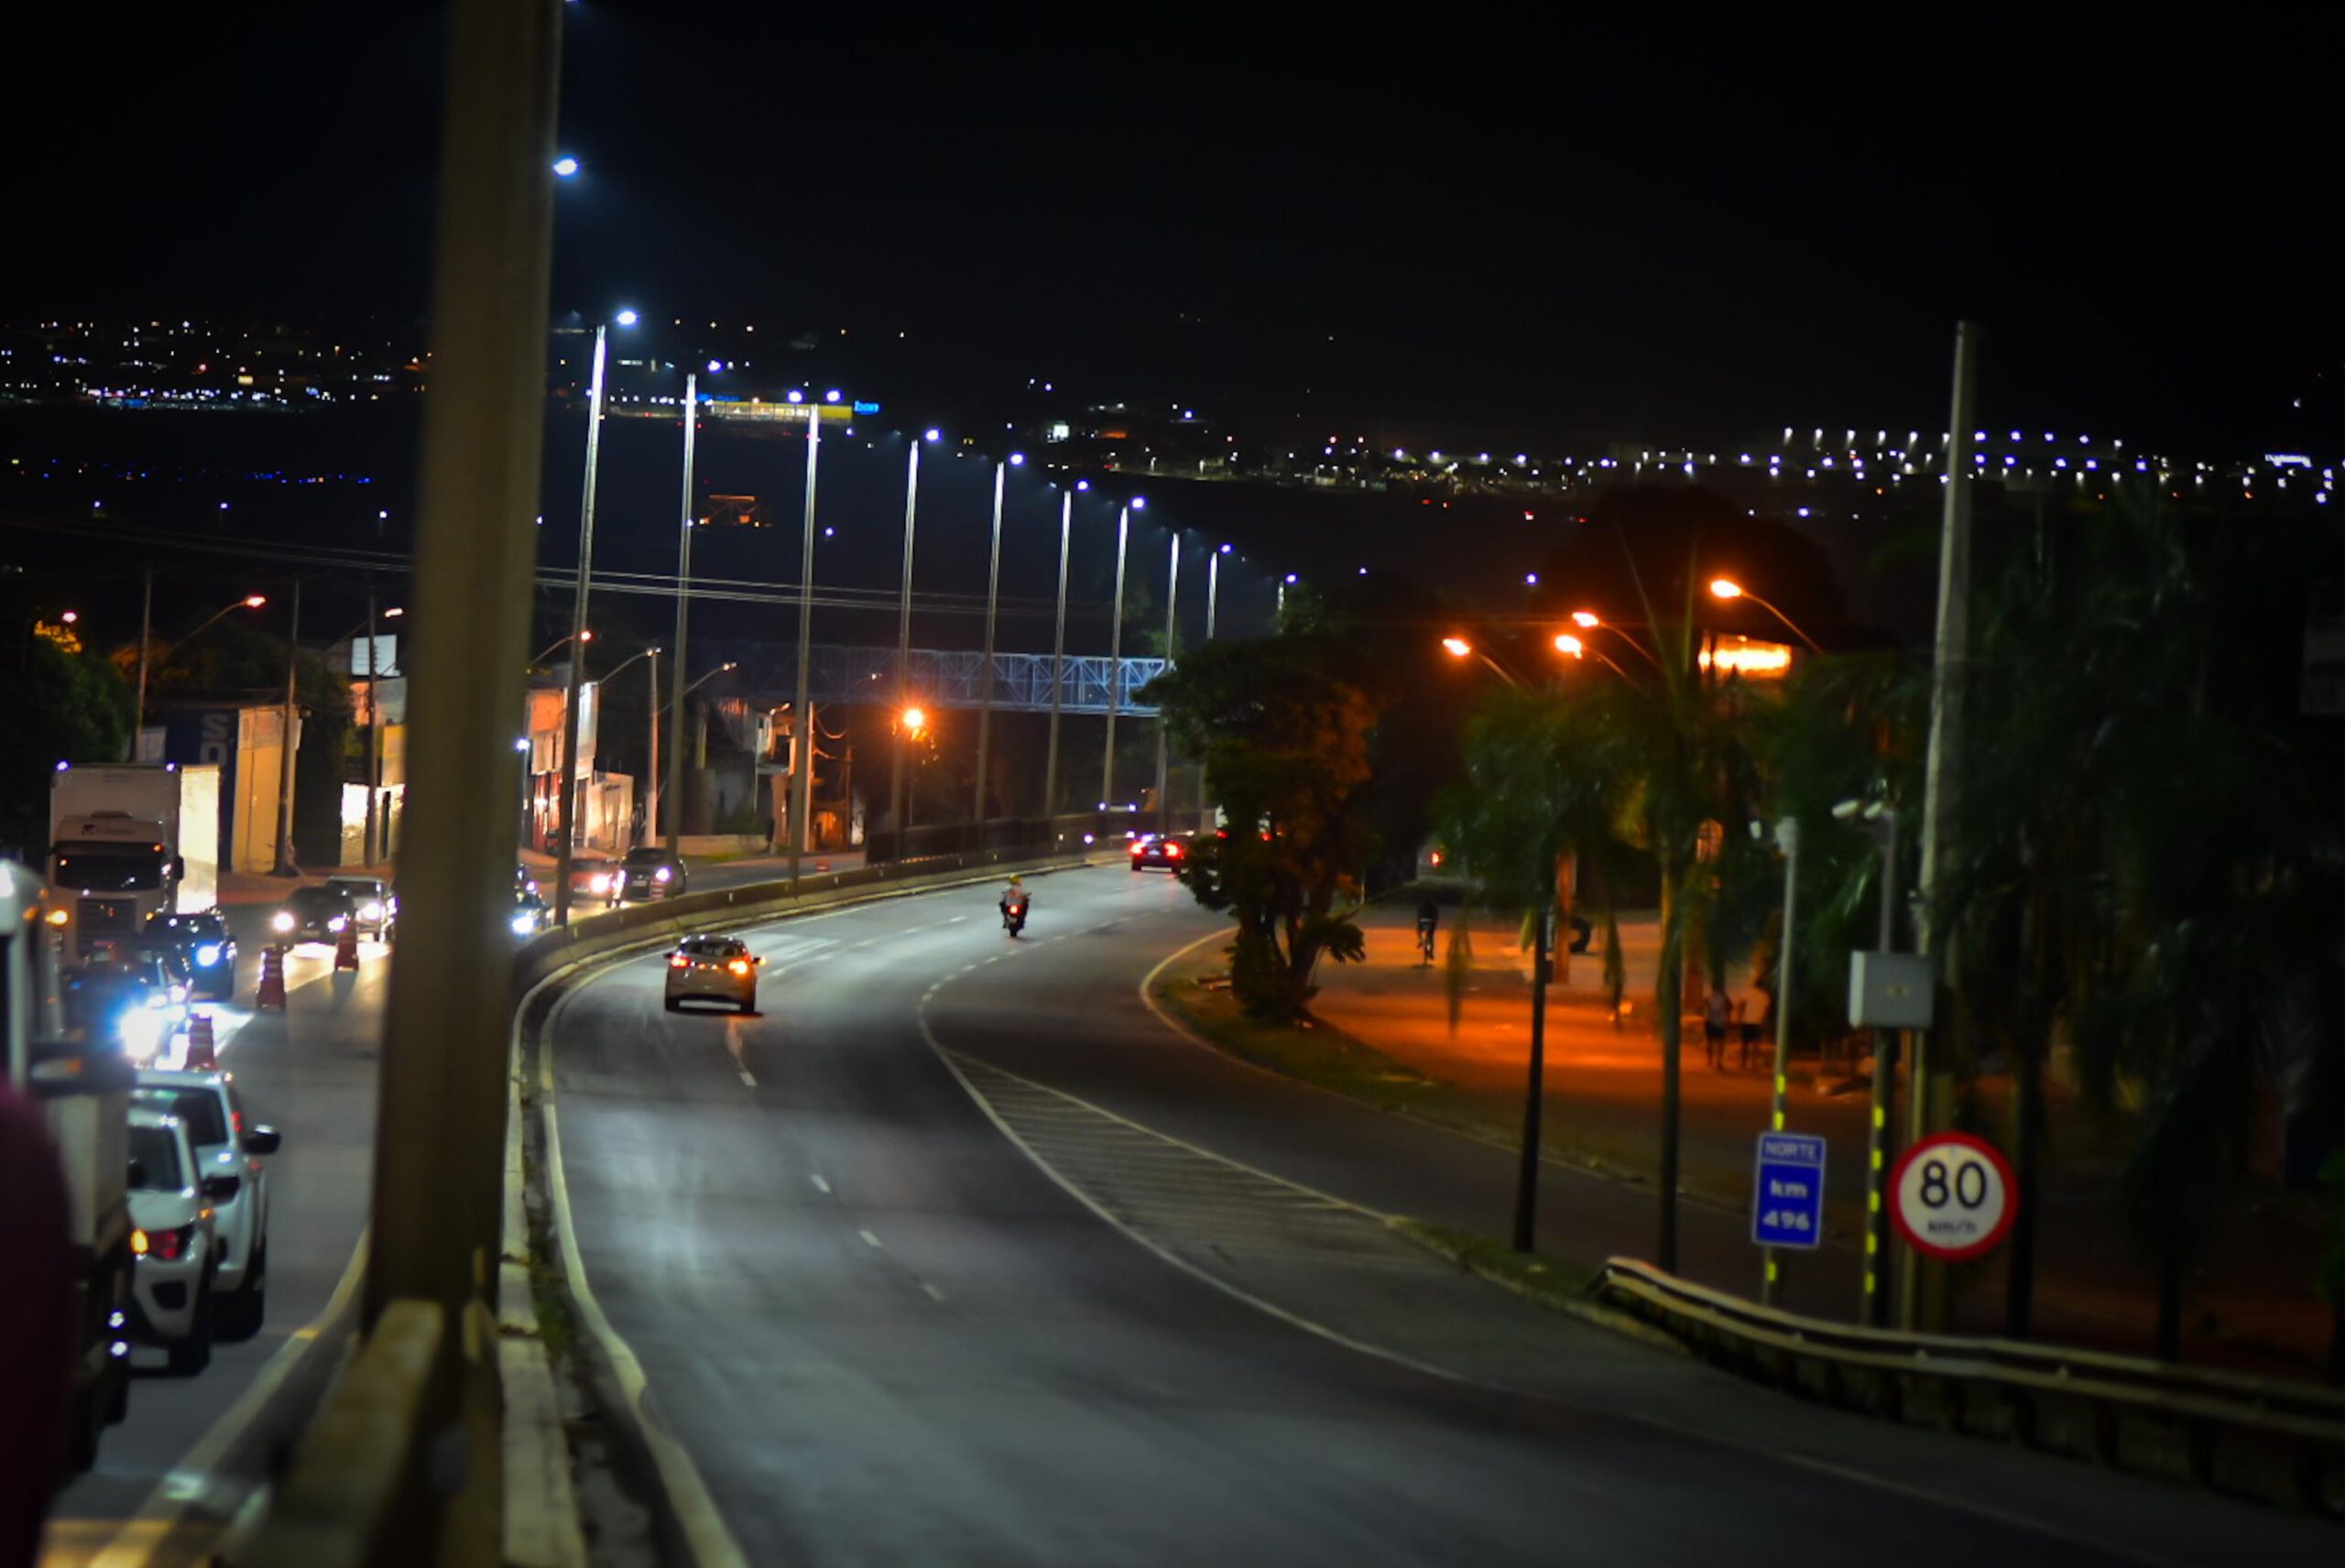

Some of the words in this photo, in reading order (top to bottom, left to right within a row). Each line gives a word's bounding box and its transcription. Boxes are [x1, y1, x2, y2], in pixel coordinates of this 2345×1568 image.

[1764, 1140, 1816, 1160] NORTE
[1770, 1178, 1808, 1199] km
[1921, 1160, 1987, 1209] 80
[1763, 1210, 1810, 1231] 496
[1927, 1218, 1977, 1235] km/h
